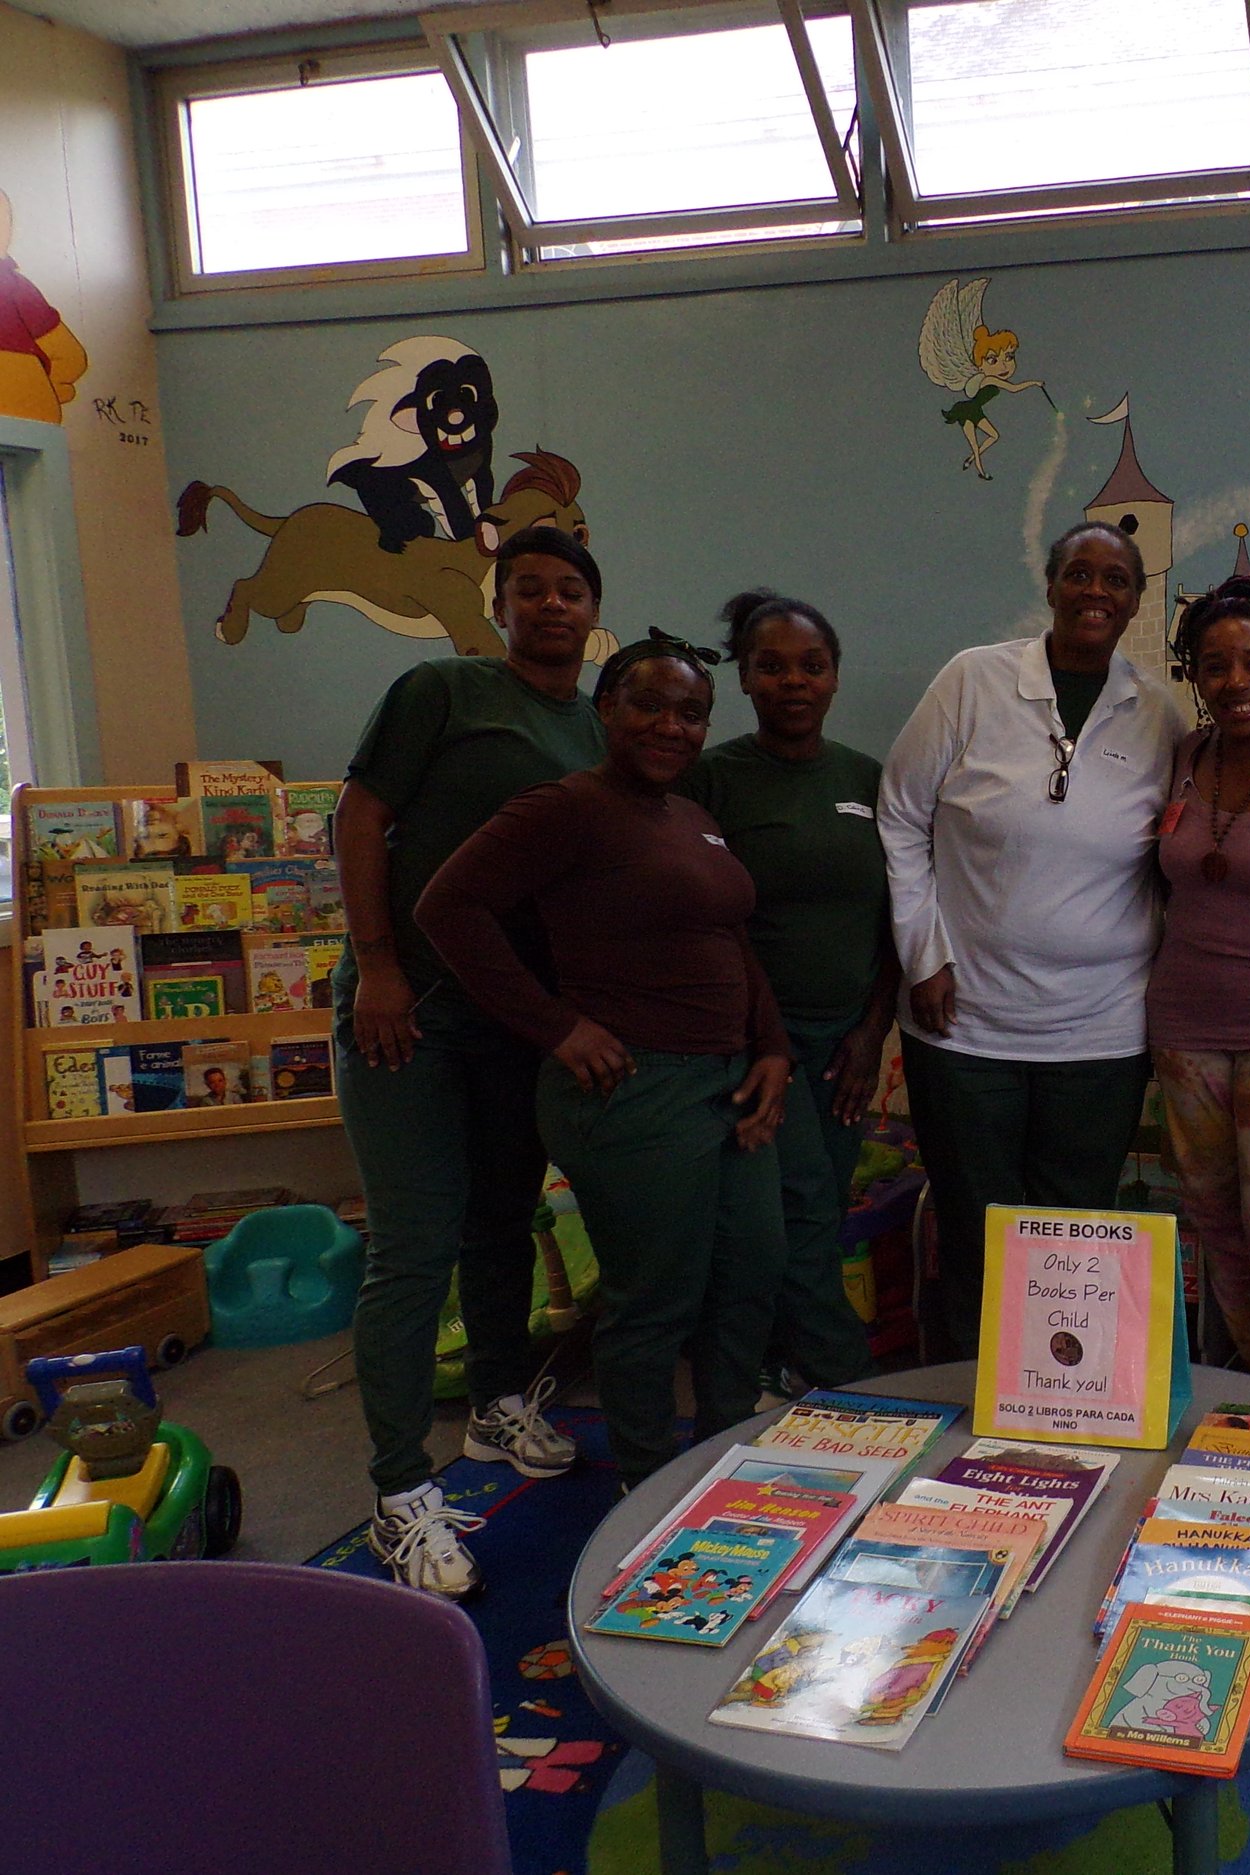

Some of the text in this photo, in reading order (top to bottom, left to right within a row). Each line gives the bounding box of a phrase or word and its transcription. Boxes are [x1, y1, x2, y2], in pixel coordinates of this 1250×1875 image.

[120, 432, 148, 446] 2017
[200, 774, 220, 783] The
[223, 773, 264, 784] Mystery
[82, 884, 123, 892] Reading
[126, 882, 149, 890] With
[73, 963, 110, 980] GUY
[68, 981, 118, 998] STUFF
[1020, 1221, 1132, 1240] FREE BOOKS
[1044, 1254, 1100, 1274] Only 2
[1028, 1280, 1116, 1302] Books Per
[1048, 1310, 1089, 1328] Child
[1024, 1370, 1107, 1392] Thank you!
[999, 1403, 1135, 1422] SOLO 2 LIBROS PARA CADA
[1052, 1420, 1078, 1430] NINO
[772, 1431, 908, 1459] THE BAD SEED
[1203, 1454, 1232, 1464] THE
[962, 1468, 1015, 1484] Eight
[1020, 1476, 1080, 1490] Lights
[914, 1494, 950, 1505] and the
[977, 1494, 1056, 1512] THE ANT
[1170, 1486, 1210, 1502] Mrs
[726, 1499, 822, 1519] Jim Henson
[880, 1511, 1028, 1535] SPIRIT CHILD
[692, 1540, 771, 1560] Mickey Mouse
[1181, 1634, 1202, 1643] The
[1142, 1638, 1236, 1658] Thank You
[1170, 1652, 1198, 1662] Book
[1127, 1730, 1144, 1741] Mo
[1146, 1731, 1191, 1747] Willems
